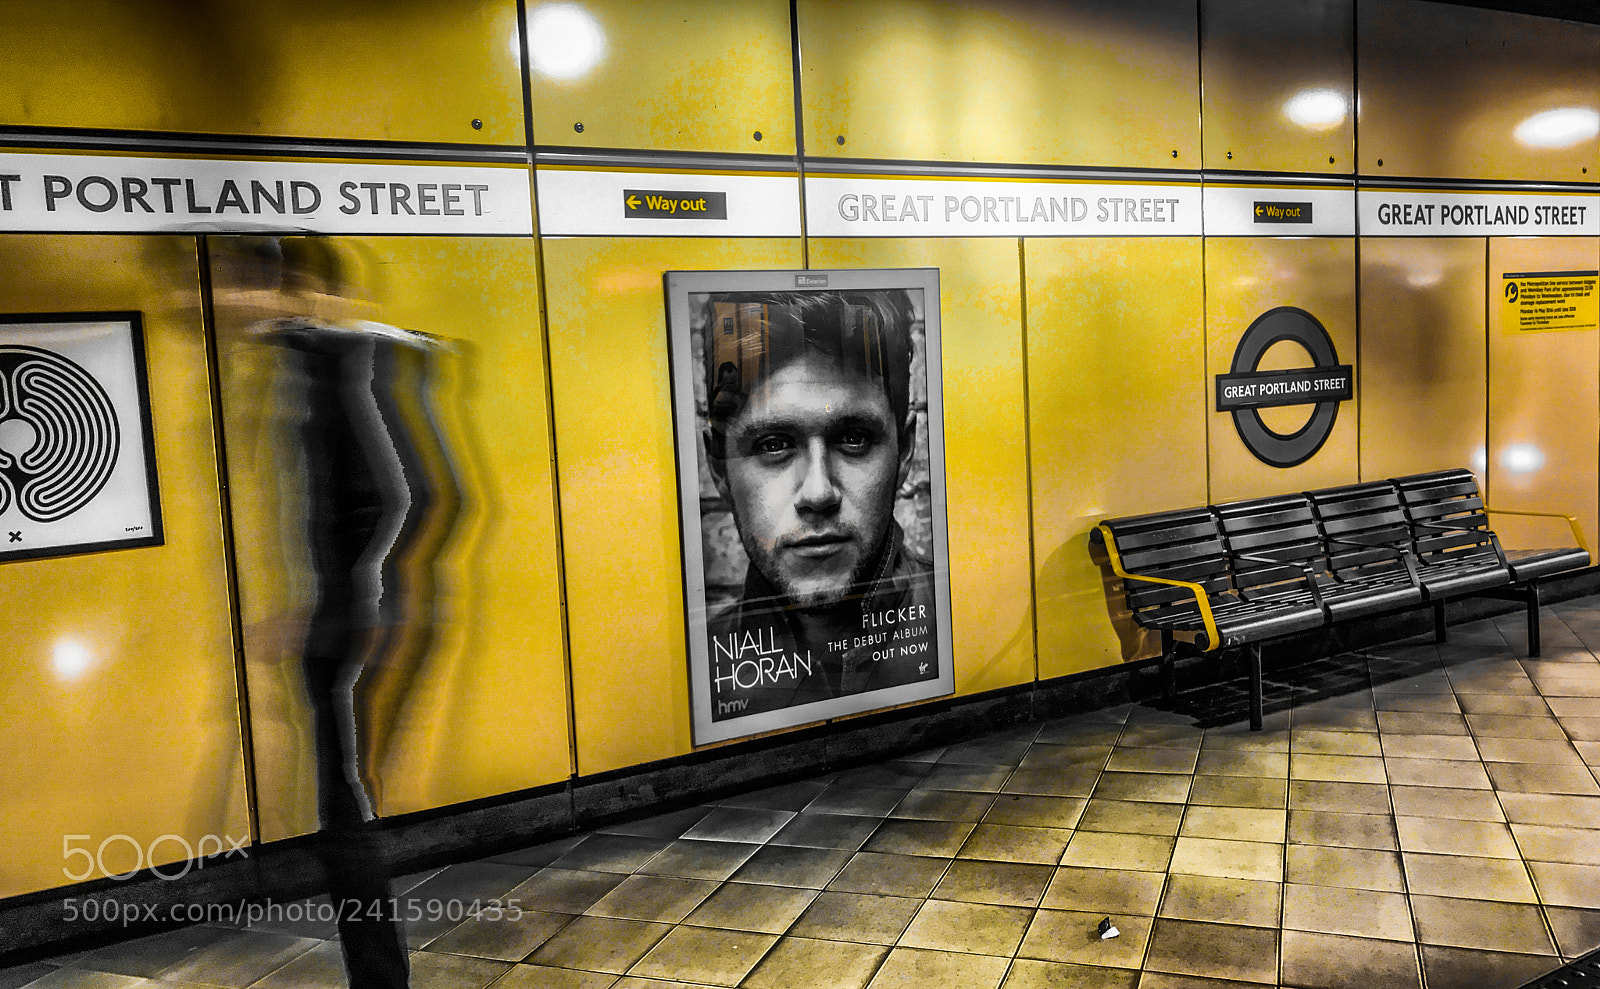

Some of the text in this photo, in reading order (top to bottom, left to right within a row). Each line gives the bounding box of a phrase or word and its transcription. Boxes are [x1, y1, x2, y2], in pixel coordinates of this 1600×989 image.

[43, 174, 323, 215] PORTLAND
[338, 180, 489, 216] STREET
[645, 195, 707, 214] Way out
[837, 193, 1180, 223] GREAT PORTLAND STREET
[1265, 204, 1301, 219] Way out
[1377, 203, 1587, 226] GREAT PORTLAND STREET
[1224, 378, 1346, 398] GREAT PORTLAND STREET
[862, 604, 927, 629] FLICKER
[713, 626, 783, 663] NIALL
[828, 625, 928, 653] THE DEBUT ALBUM
[872, 642, 929, 662] OUT NOW
[714, 650, 812, 693] HORAN
[718, 699, 749, 716] hmv
